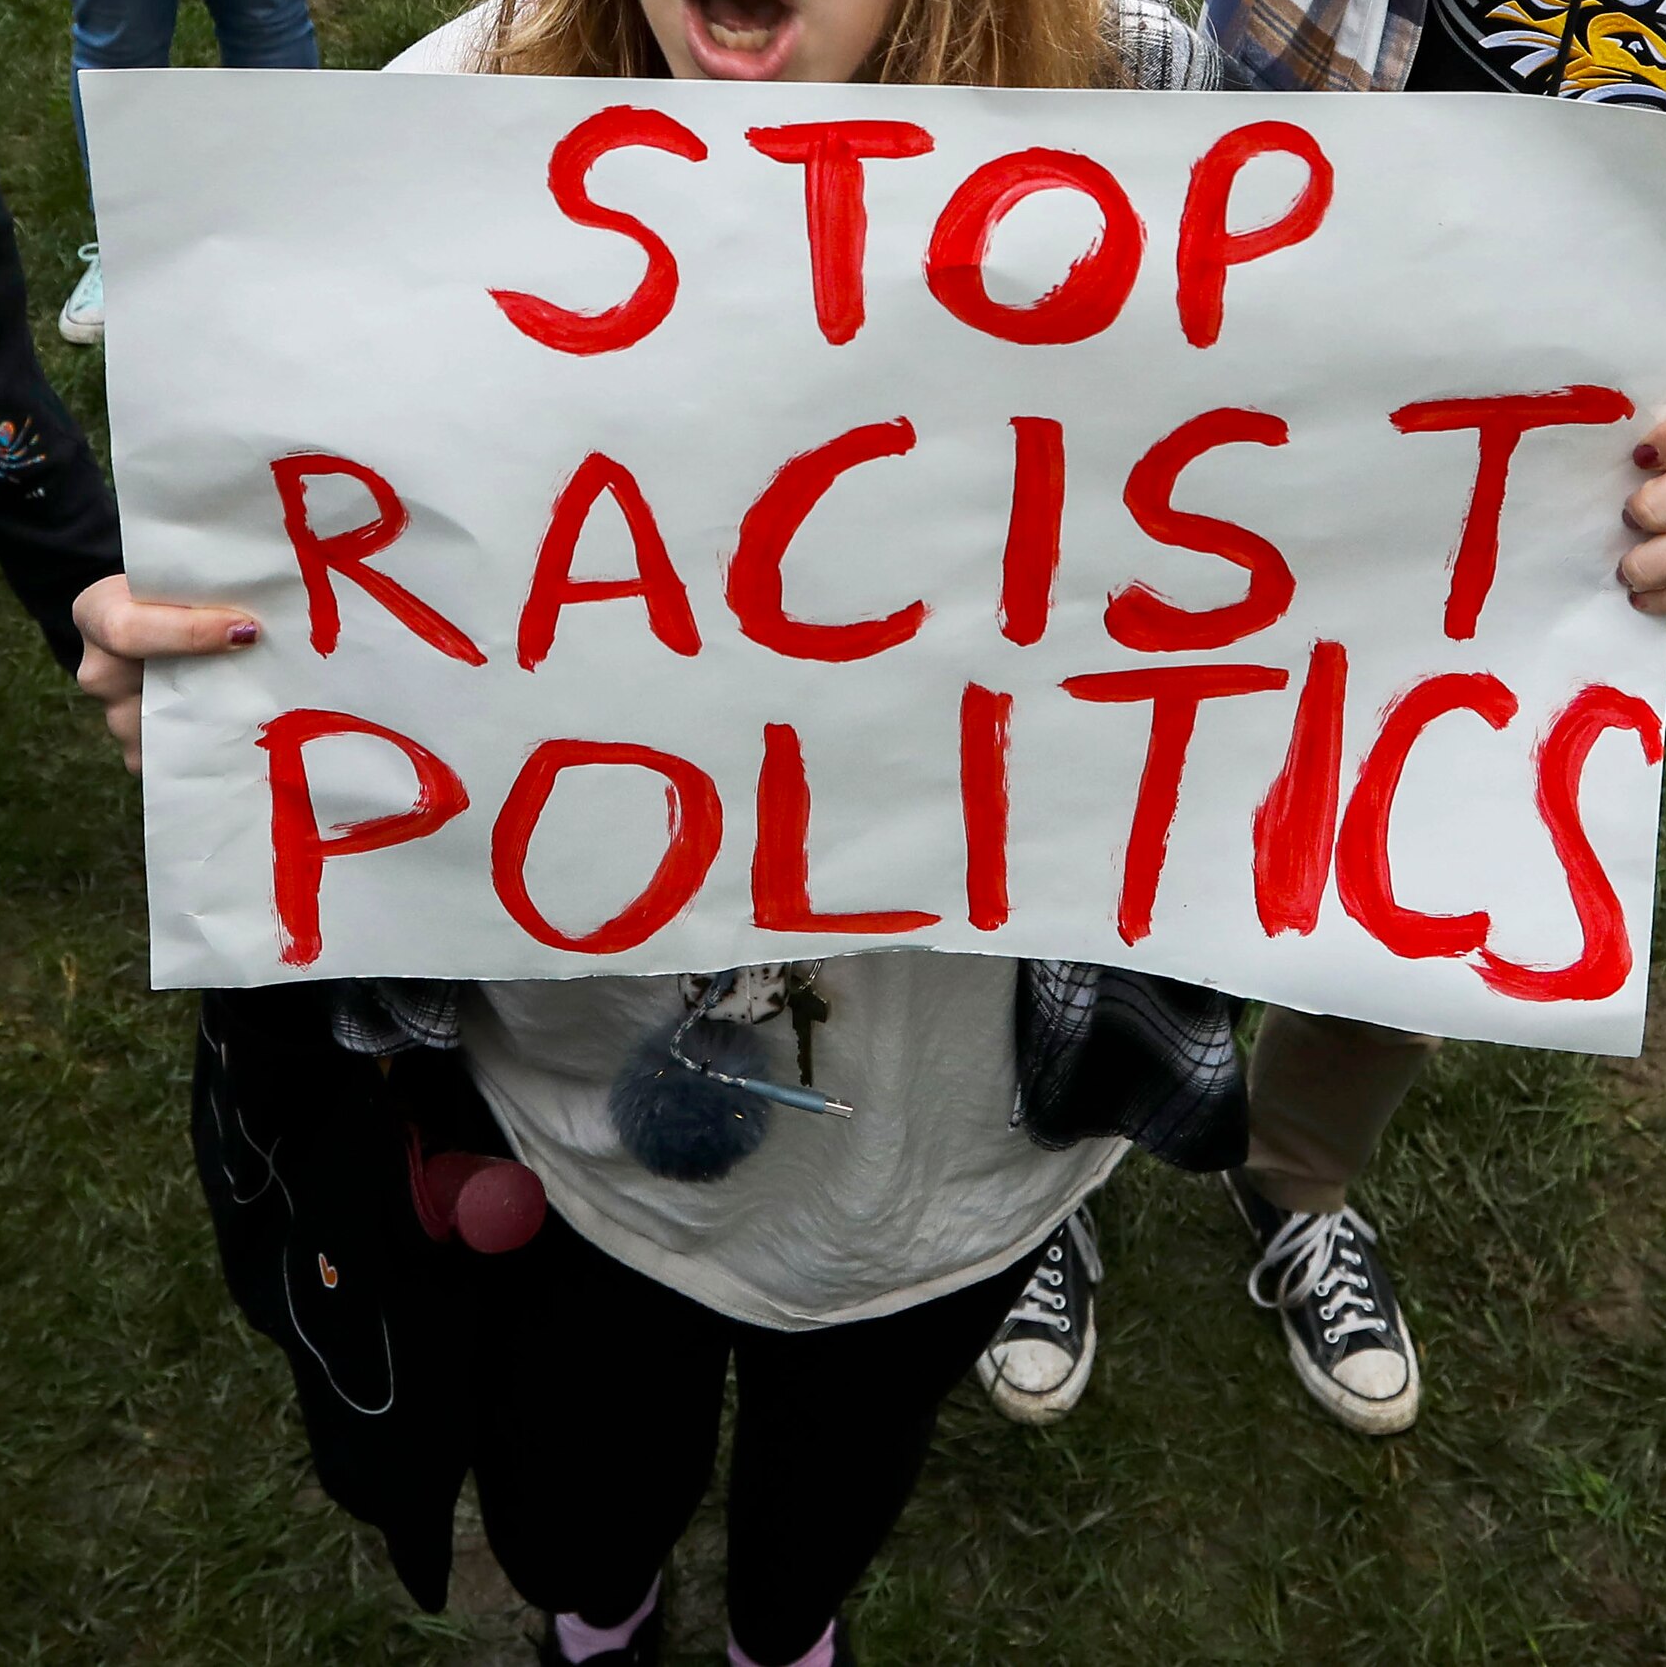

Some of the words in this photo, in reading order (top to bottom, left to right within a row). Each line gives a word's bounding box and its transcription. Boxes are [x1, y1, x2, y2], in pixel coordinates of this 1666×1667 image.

[485, 103, 1335, 358] STOP
[268, 384, 1637, 674] RACIST
[254, 638, 1665, 1005] POLITICS
